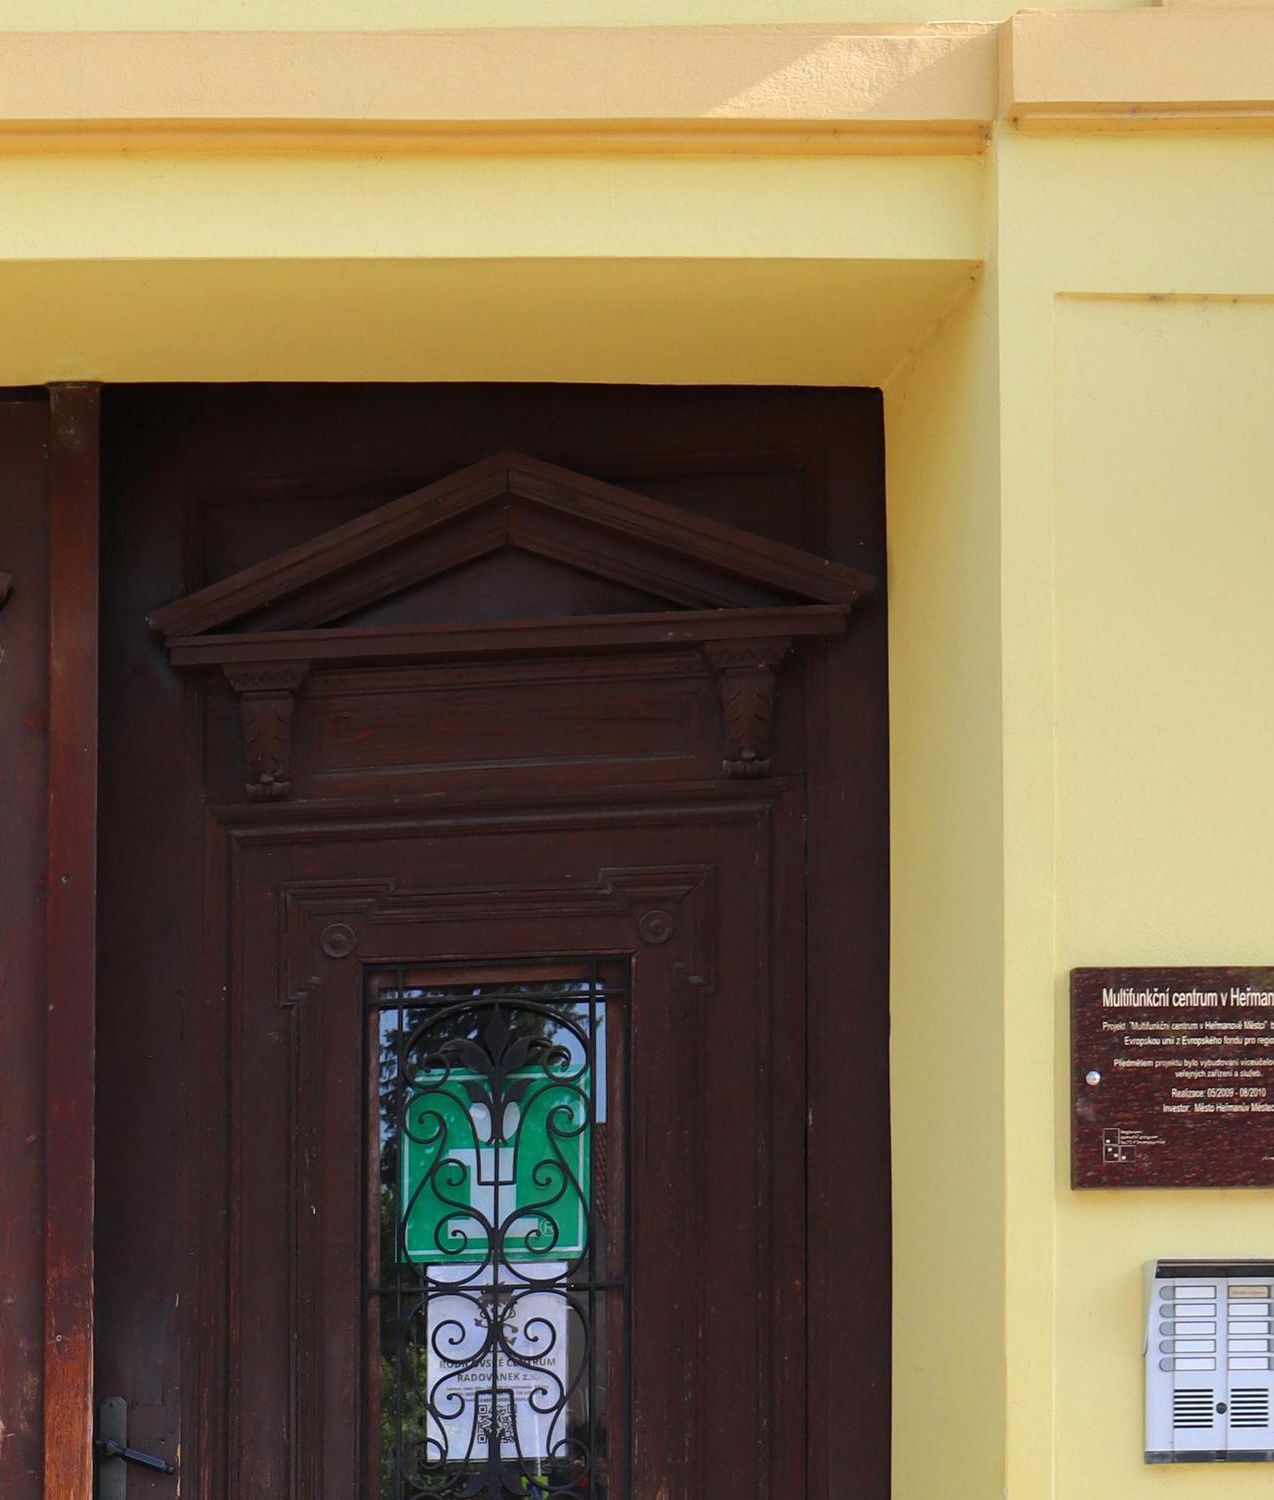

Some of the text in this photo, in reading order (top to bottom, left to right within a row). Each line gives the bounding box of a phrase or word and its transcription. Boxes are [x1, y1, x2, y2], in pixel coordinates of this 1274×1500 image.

[1102, 987, 1170, 1007] Multifunkční
[1172, 988, 1218, 1007] centrum
[1220, 992, 1228, 1007] v
[1171, 1022, 1199, 1030] centrum
[1124, 1035, 1161, 1047] Evropskou
[1182, 1035, 1222, 1047] Evropského
[1223, 1035, 1243, 1045] fondu
[1244, 1037, 1256, 1046] pro
[1183, 1058, 1199, 1068] bylo
[1194, 1103, 1215, 1112] Město
[1216, 1103, 1250, 1112] Heřmanův
